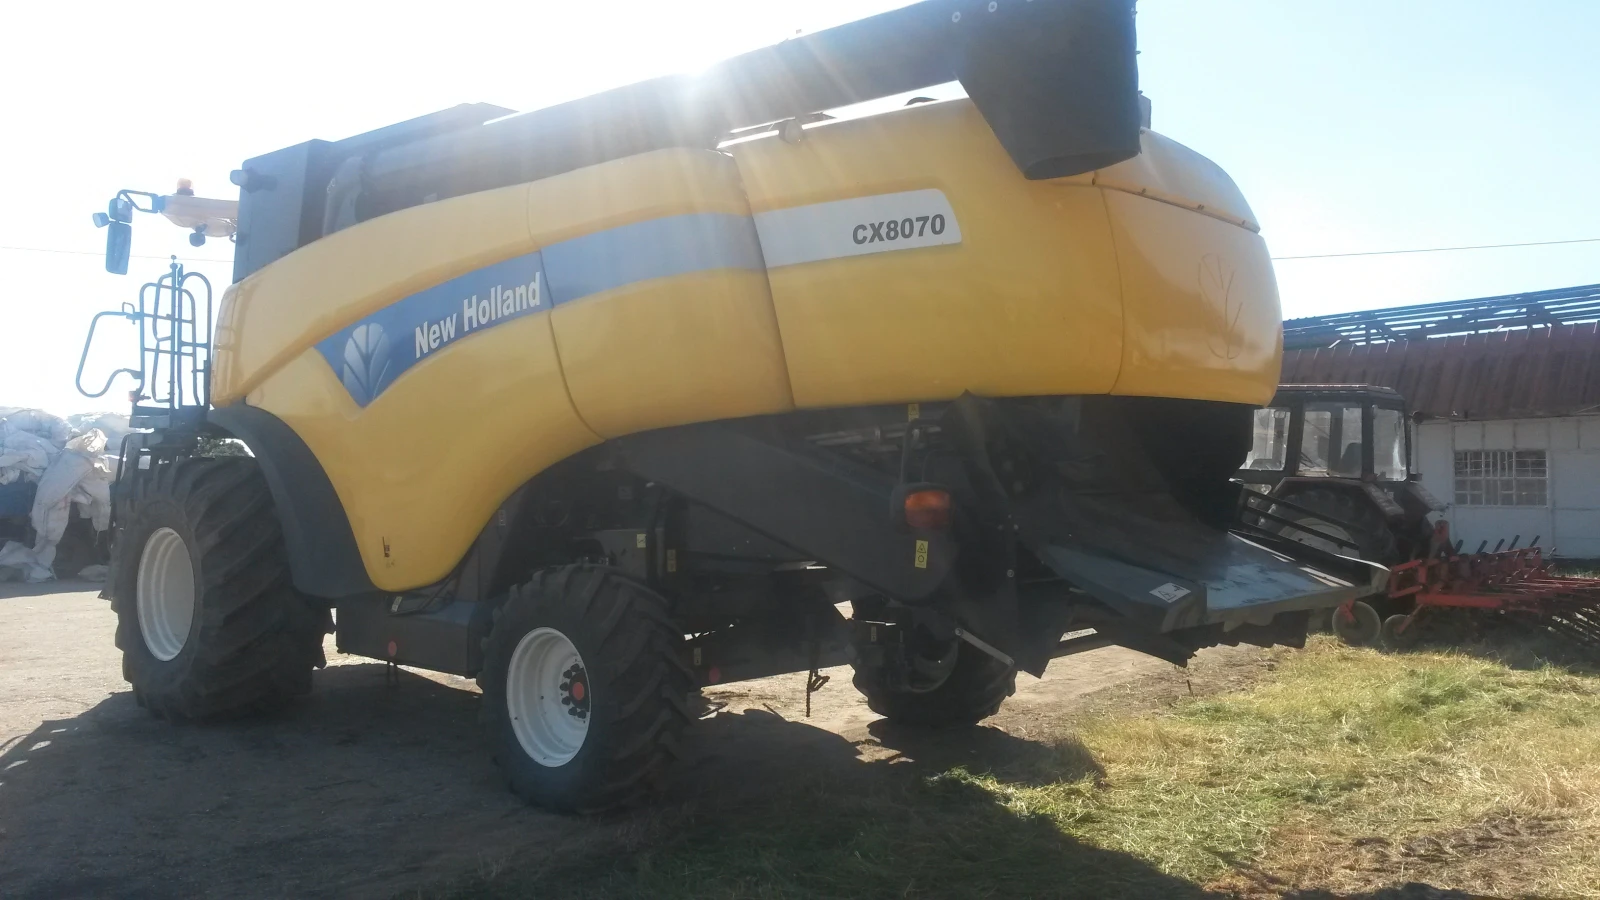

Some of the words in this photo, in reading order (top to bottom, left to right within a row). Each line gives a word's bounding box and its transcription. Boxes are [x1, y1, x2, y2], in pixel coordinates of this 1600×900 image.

[852, 213, 945, 245] CX8070
[415, 312, 457, 358] New
[463, 272, 540, 332] Holland
